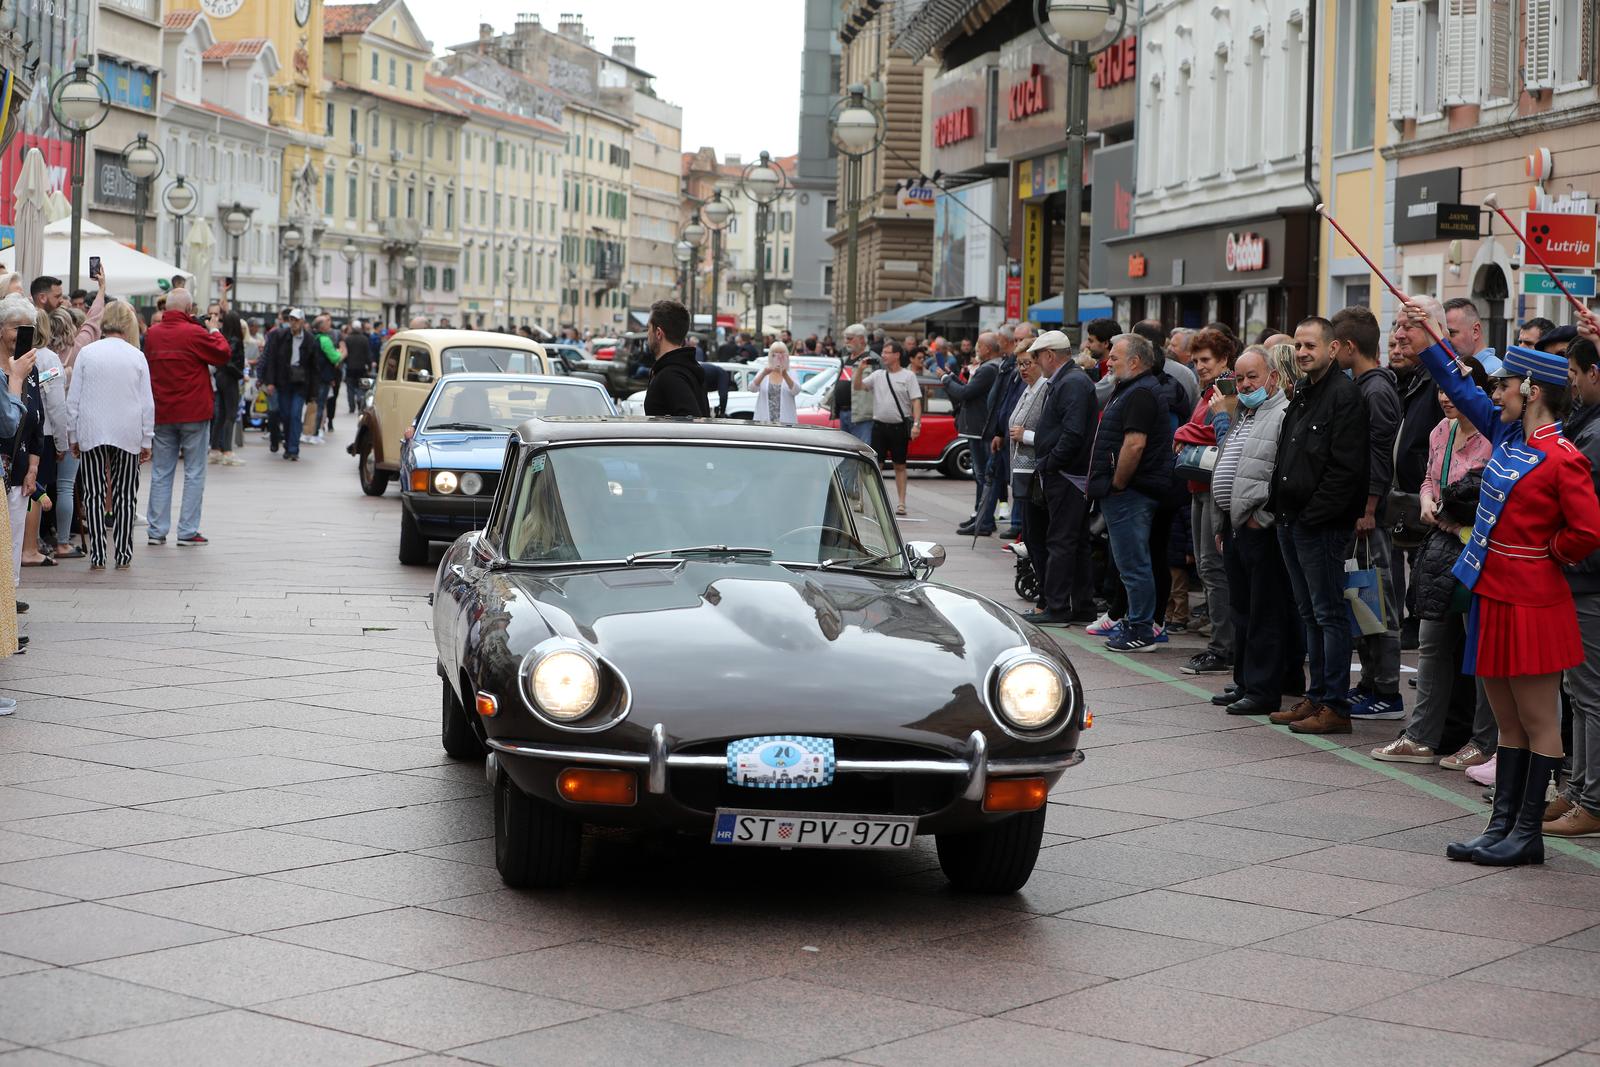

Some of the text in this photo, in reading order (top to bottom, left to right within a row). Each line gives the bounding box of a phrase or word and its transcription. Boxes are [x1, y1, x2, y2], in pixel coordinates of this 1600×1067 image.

[934, 106, 973, 149] ROBNA
[1546, 239, 1590, 255] Lutrija
[717, 831, 732, 839] HR
[737, 817, 909, 847] ST PV-970
